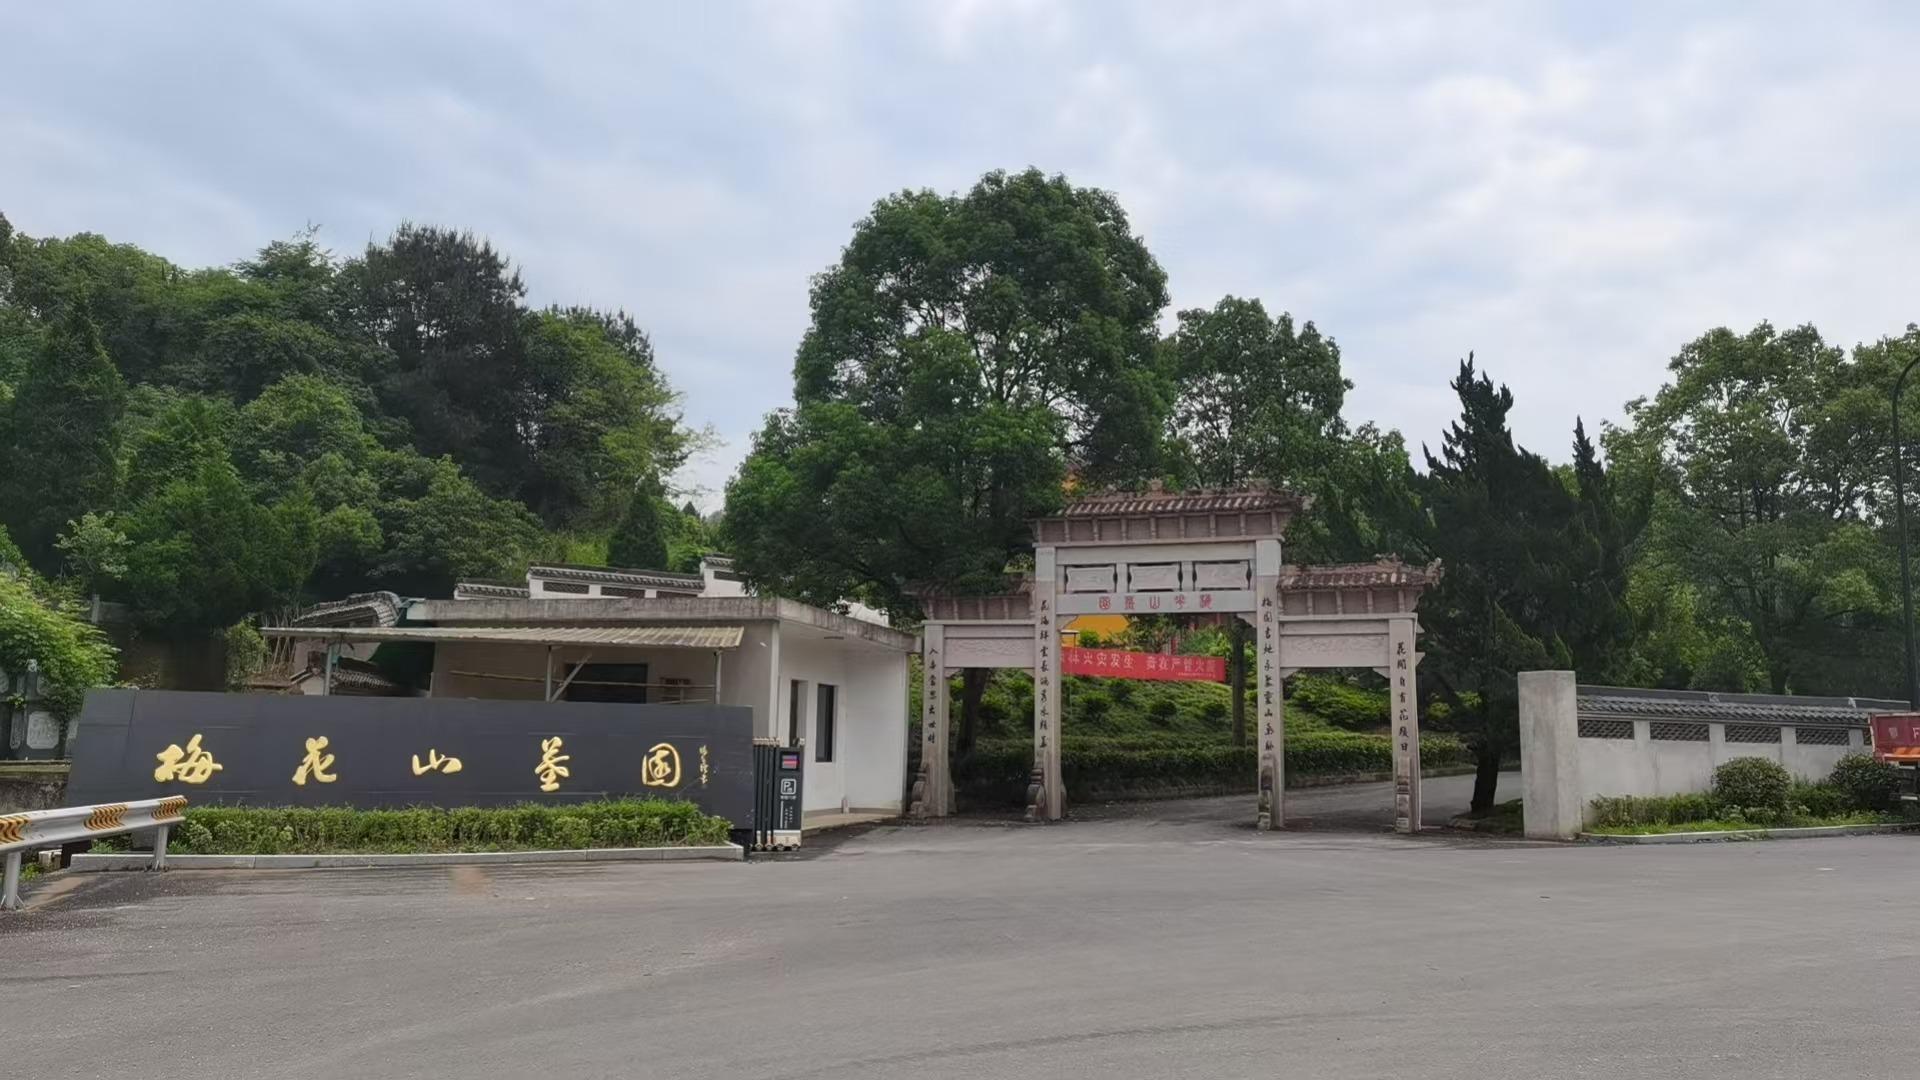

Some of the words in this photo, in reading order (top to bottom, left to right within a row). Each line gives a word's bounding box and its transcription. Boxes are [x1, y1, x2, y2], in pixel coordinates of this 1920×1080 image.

[1063, 650, 1134, 669] 林火灾发生
